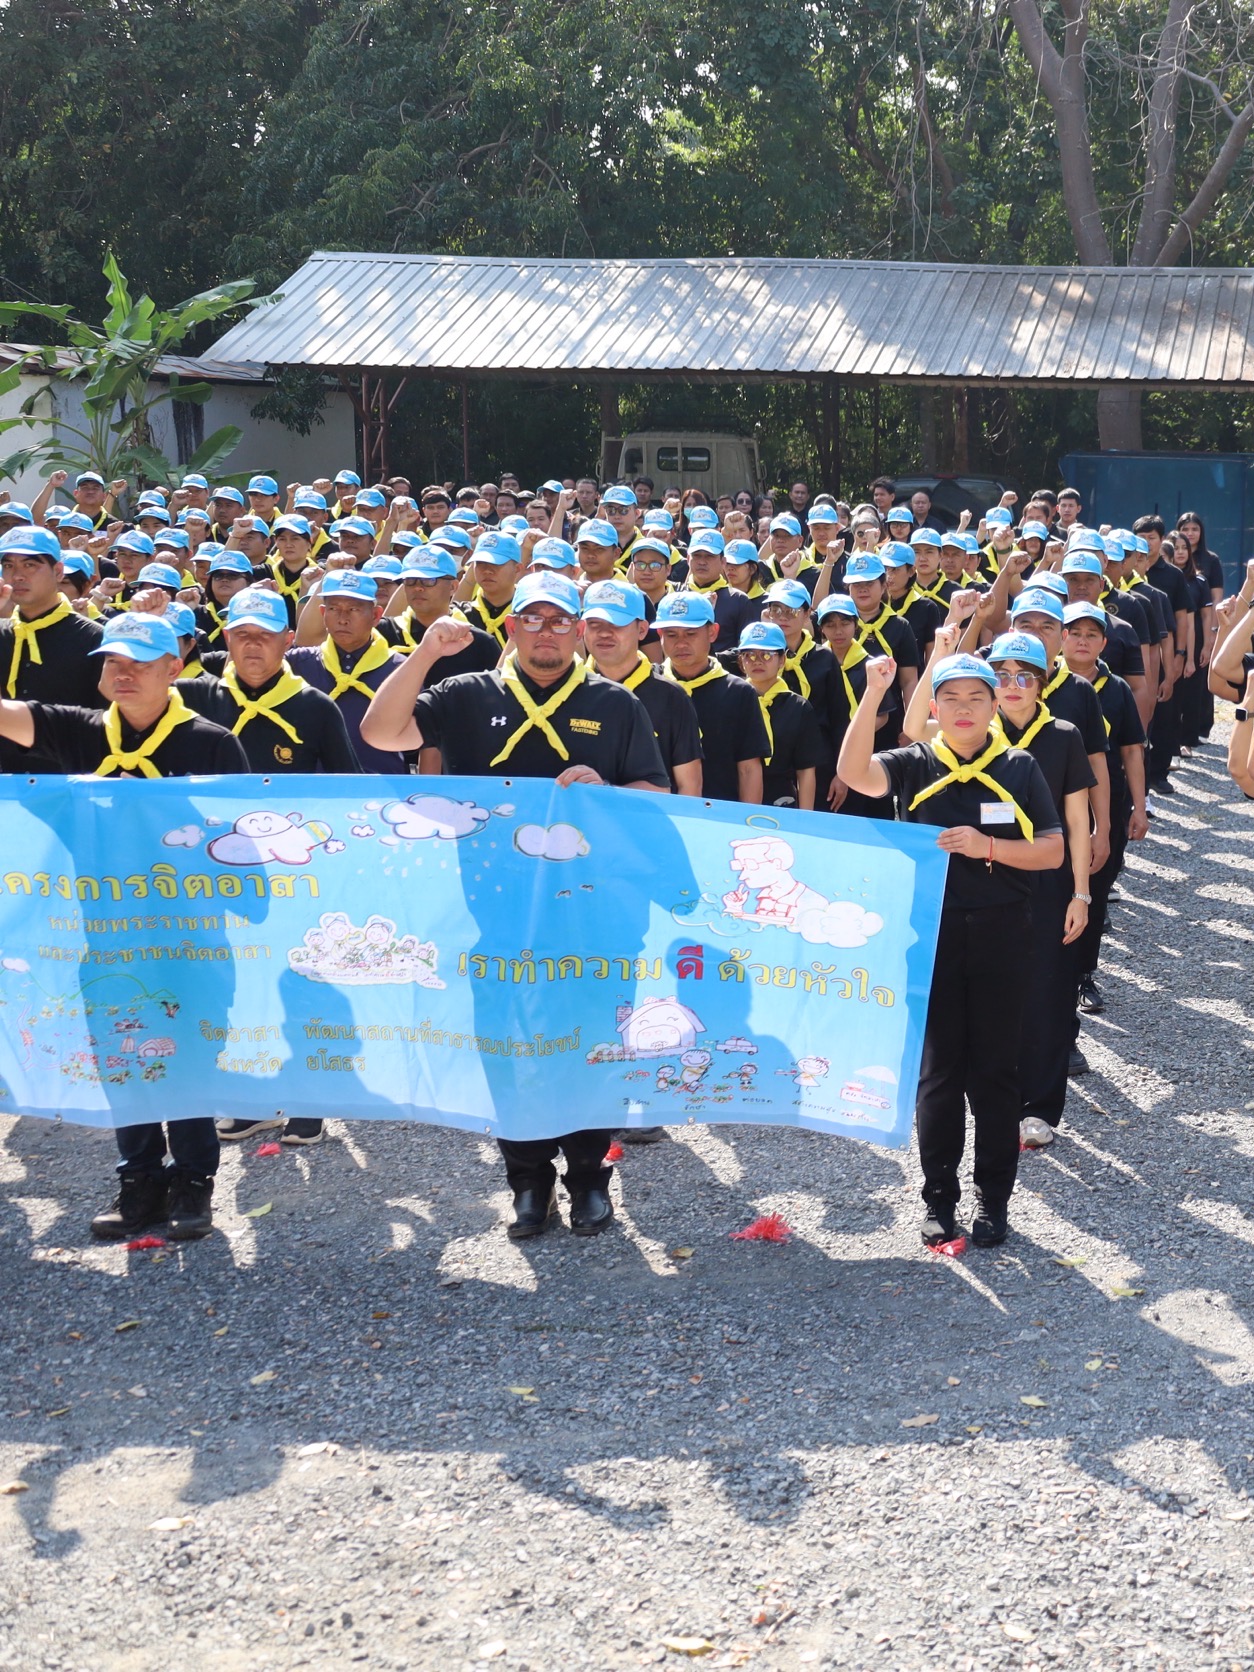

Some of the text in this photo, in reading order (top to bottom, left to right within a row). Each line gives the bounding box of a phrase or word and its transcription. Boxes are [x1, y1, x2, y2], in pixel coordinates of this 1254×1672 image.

[0, 863, 321, 901] ครงการจิตอาสา
[48, 910, 250, 934] หน่วยพระราชทาน
[38, 940, 272, 965] และประชาชนจิตอาสา
[456, 944, 896, 1008] เราทำความ ดี ด้วยหัวใจ
[199, 1016, 581, 1057] จิตอาสา พัฒนาสถานที่สาธารณประโยชน์
[215, 1048, 366, 1073] จังหวัด ยโสธร
